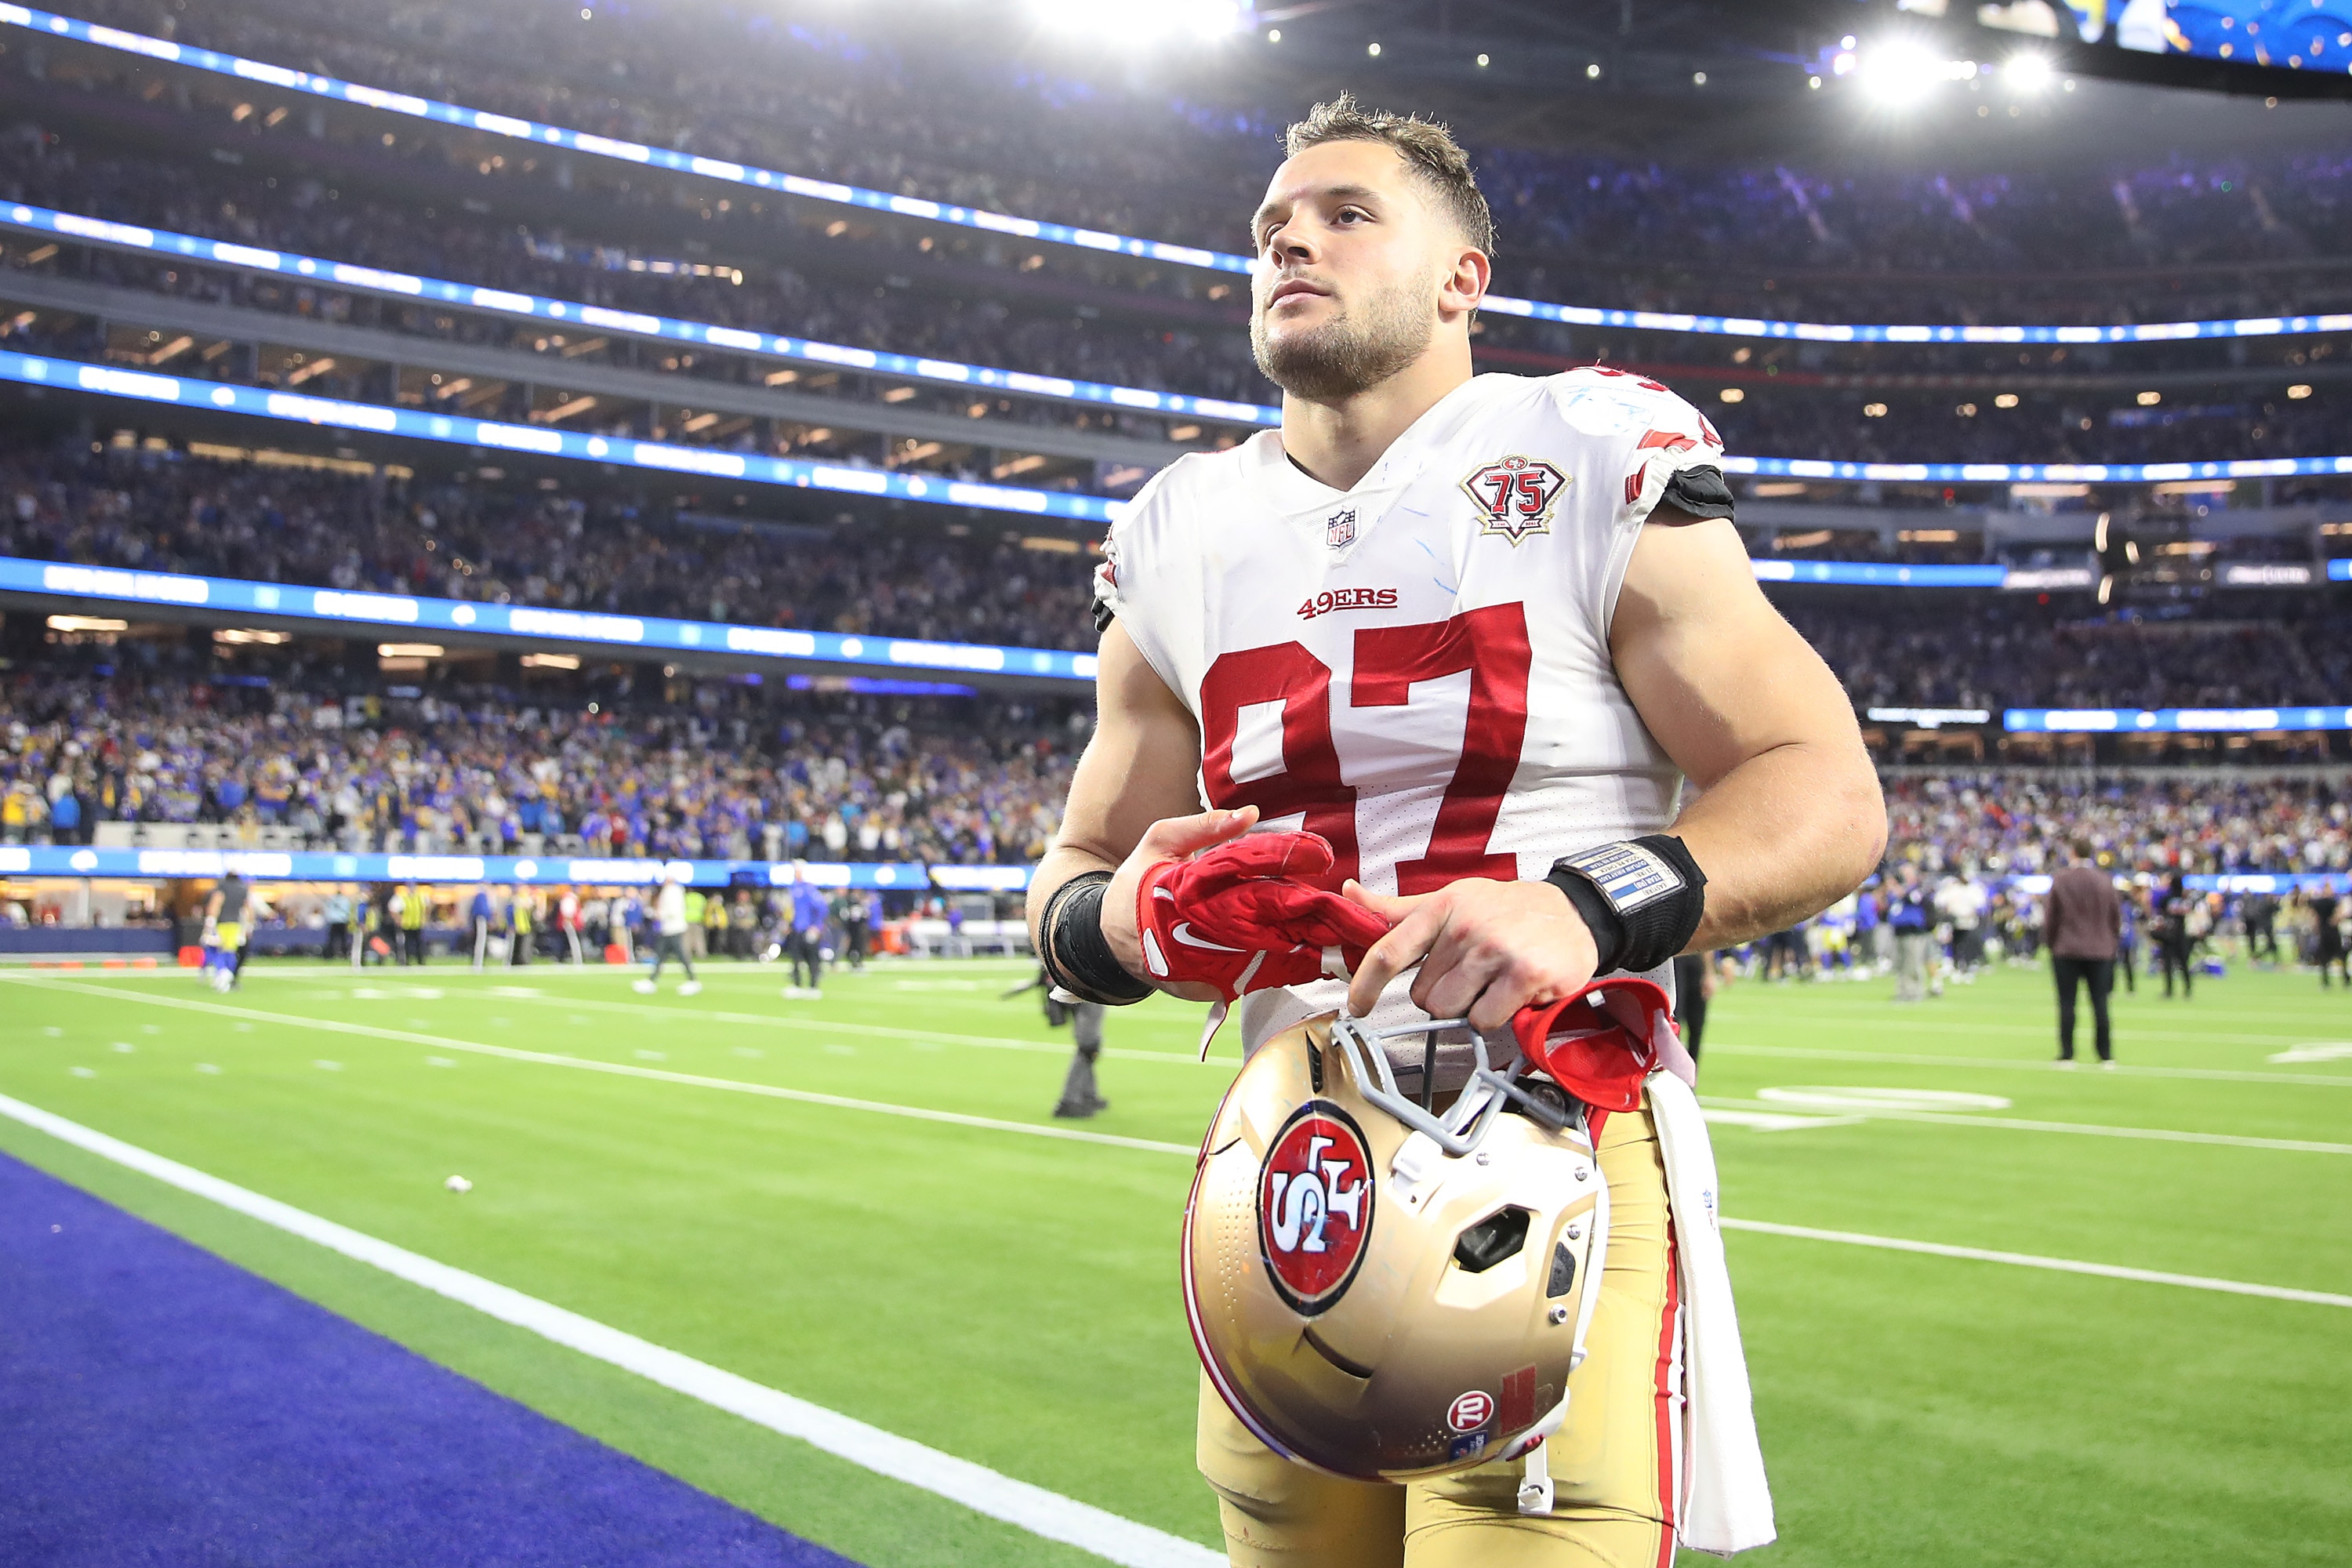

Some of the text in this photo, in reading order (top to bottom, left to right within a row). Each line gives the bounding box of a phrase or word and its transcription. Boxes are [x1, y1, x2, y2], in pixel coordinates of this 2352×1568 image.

[1485, 470, 1545, 516] 75
[1330, 524, 1352, 543] NFL
[1297, 588, 1398, 620] 49ERS
[1200, 601, 1532, 898] 97
[1271, 1135, 1361, 1253] SF
[1457, 1396, 1484, 1428] 70
